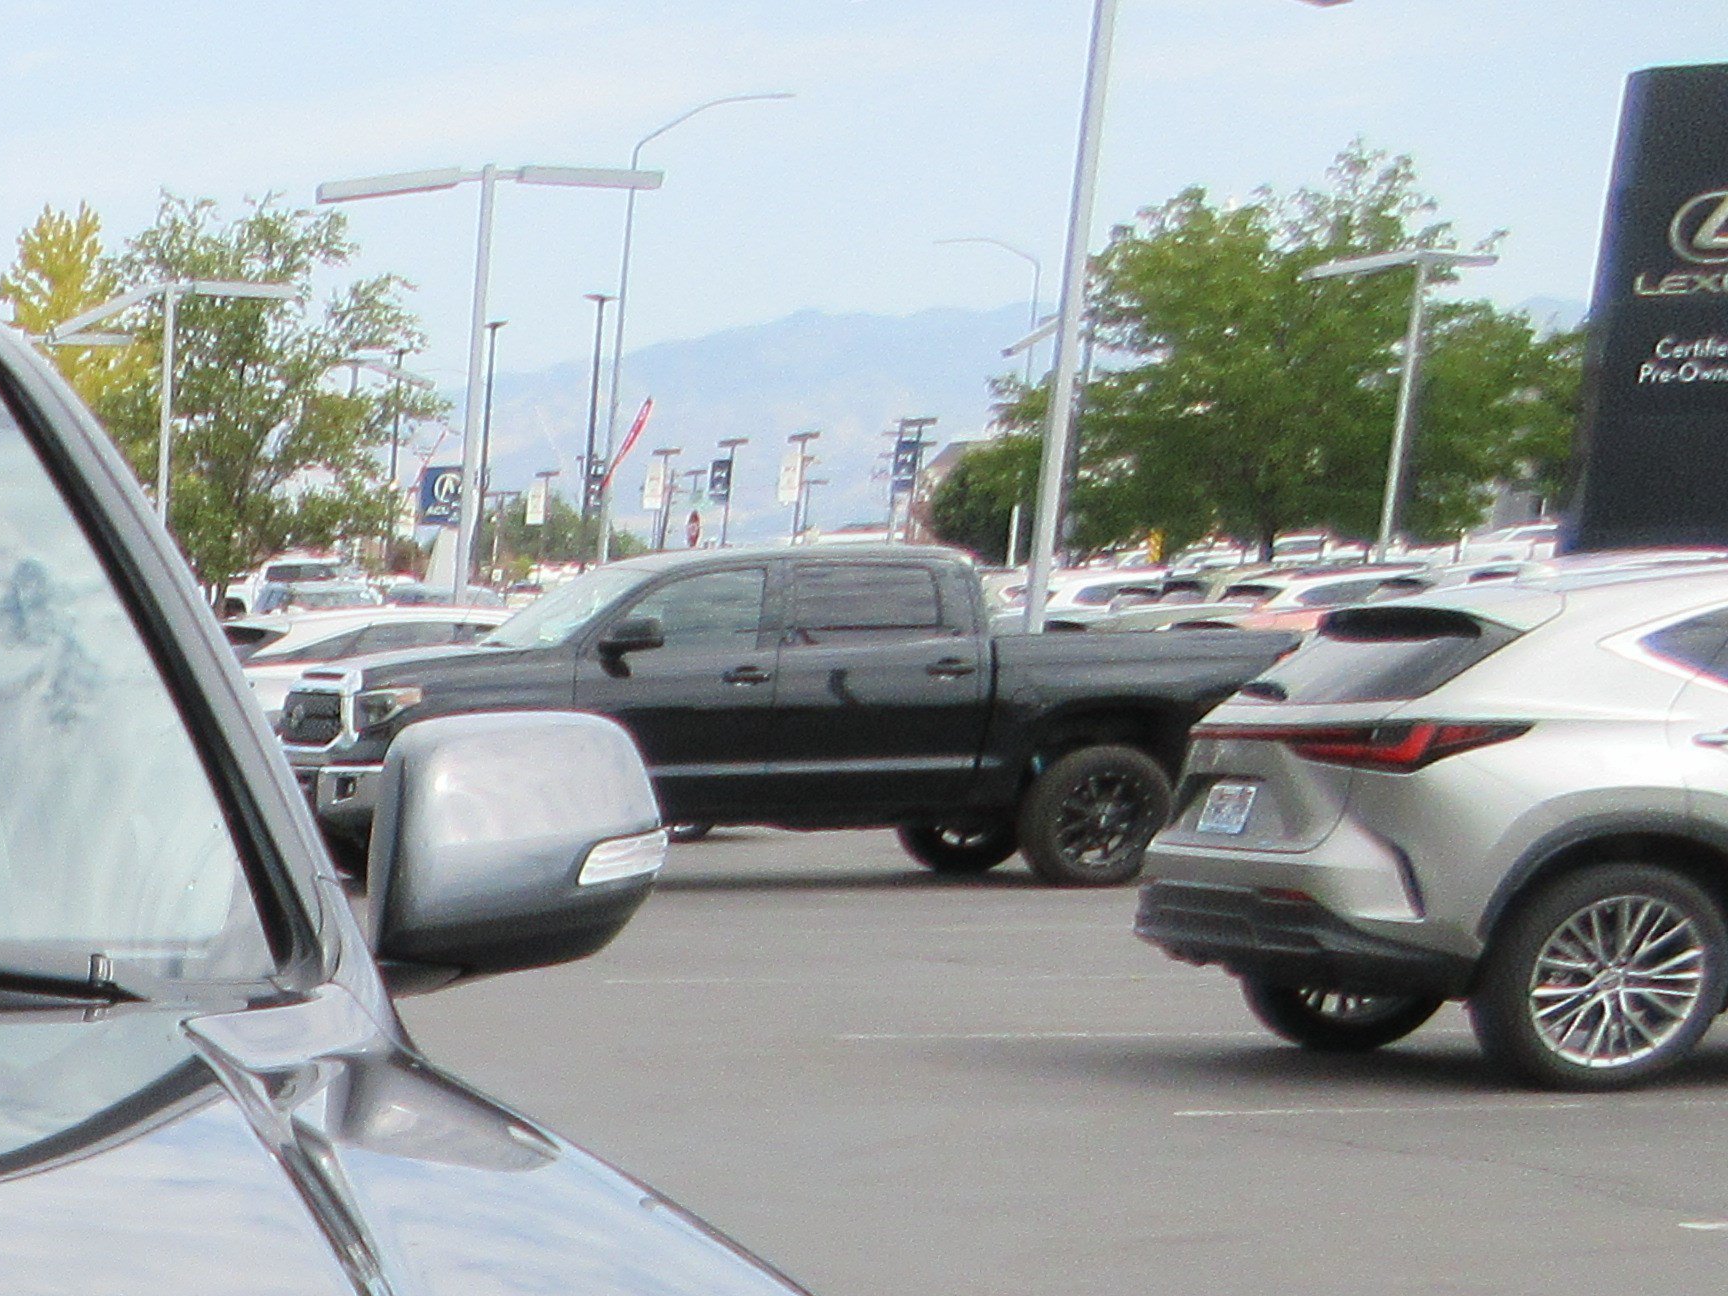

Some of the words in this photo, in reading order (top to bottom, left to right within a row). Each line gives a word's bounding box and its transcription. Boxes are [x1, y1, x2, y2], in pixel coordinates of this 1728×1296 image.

[1633, 272, 1728, 295] LEX
[1655, 335, 1728, 359] Certifie
[1638, 361, 1728, 384] Pre-Own
